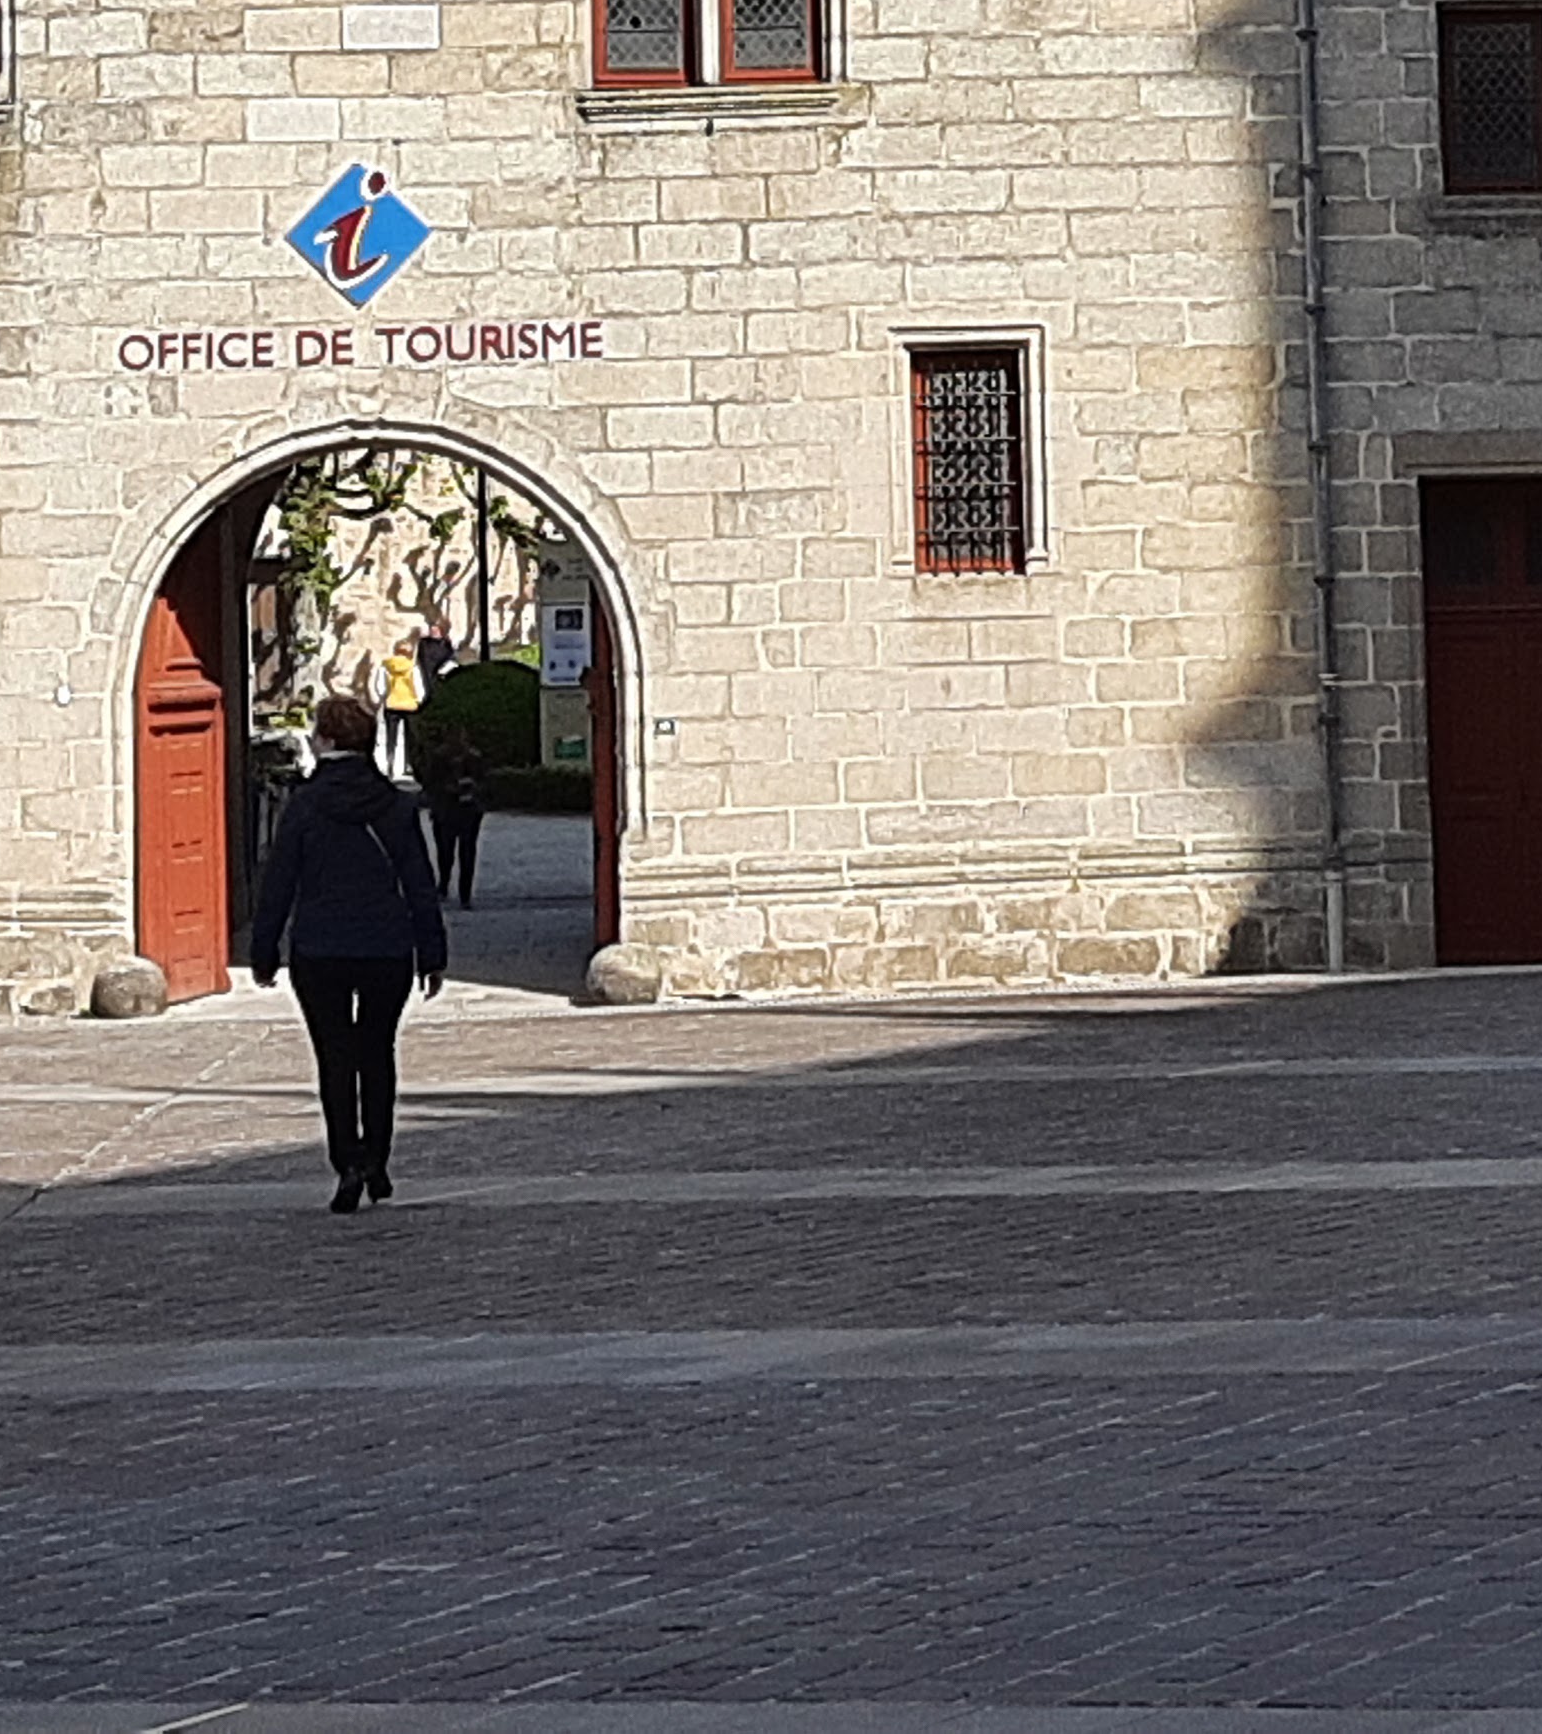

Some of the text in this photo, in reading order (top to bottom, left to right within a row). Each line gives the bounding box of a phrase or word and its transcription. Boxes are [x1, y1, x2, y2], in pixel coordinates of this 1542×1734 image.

[118, 321, 604, 371] OFFICE DE TOURISME
